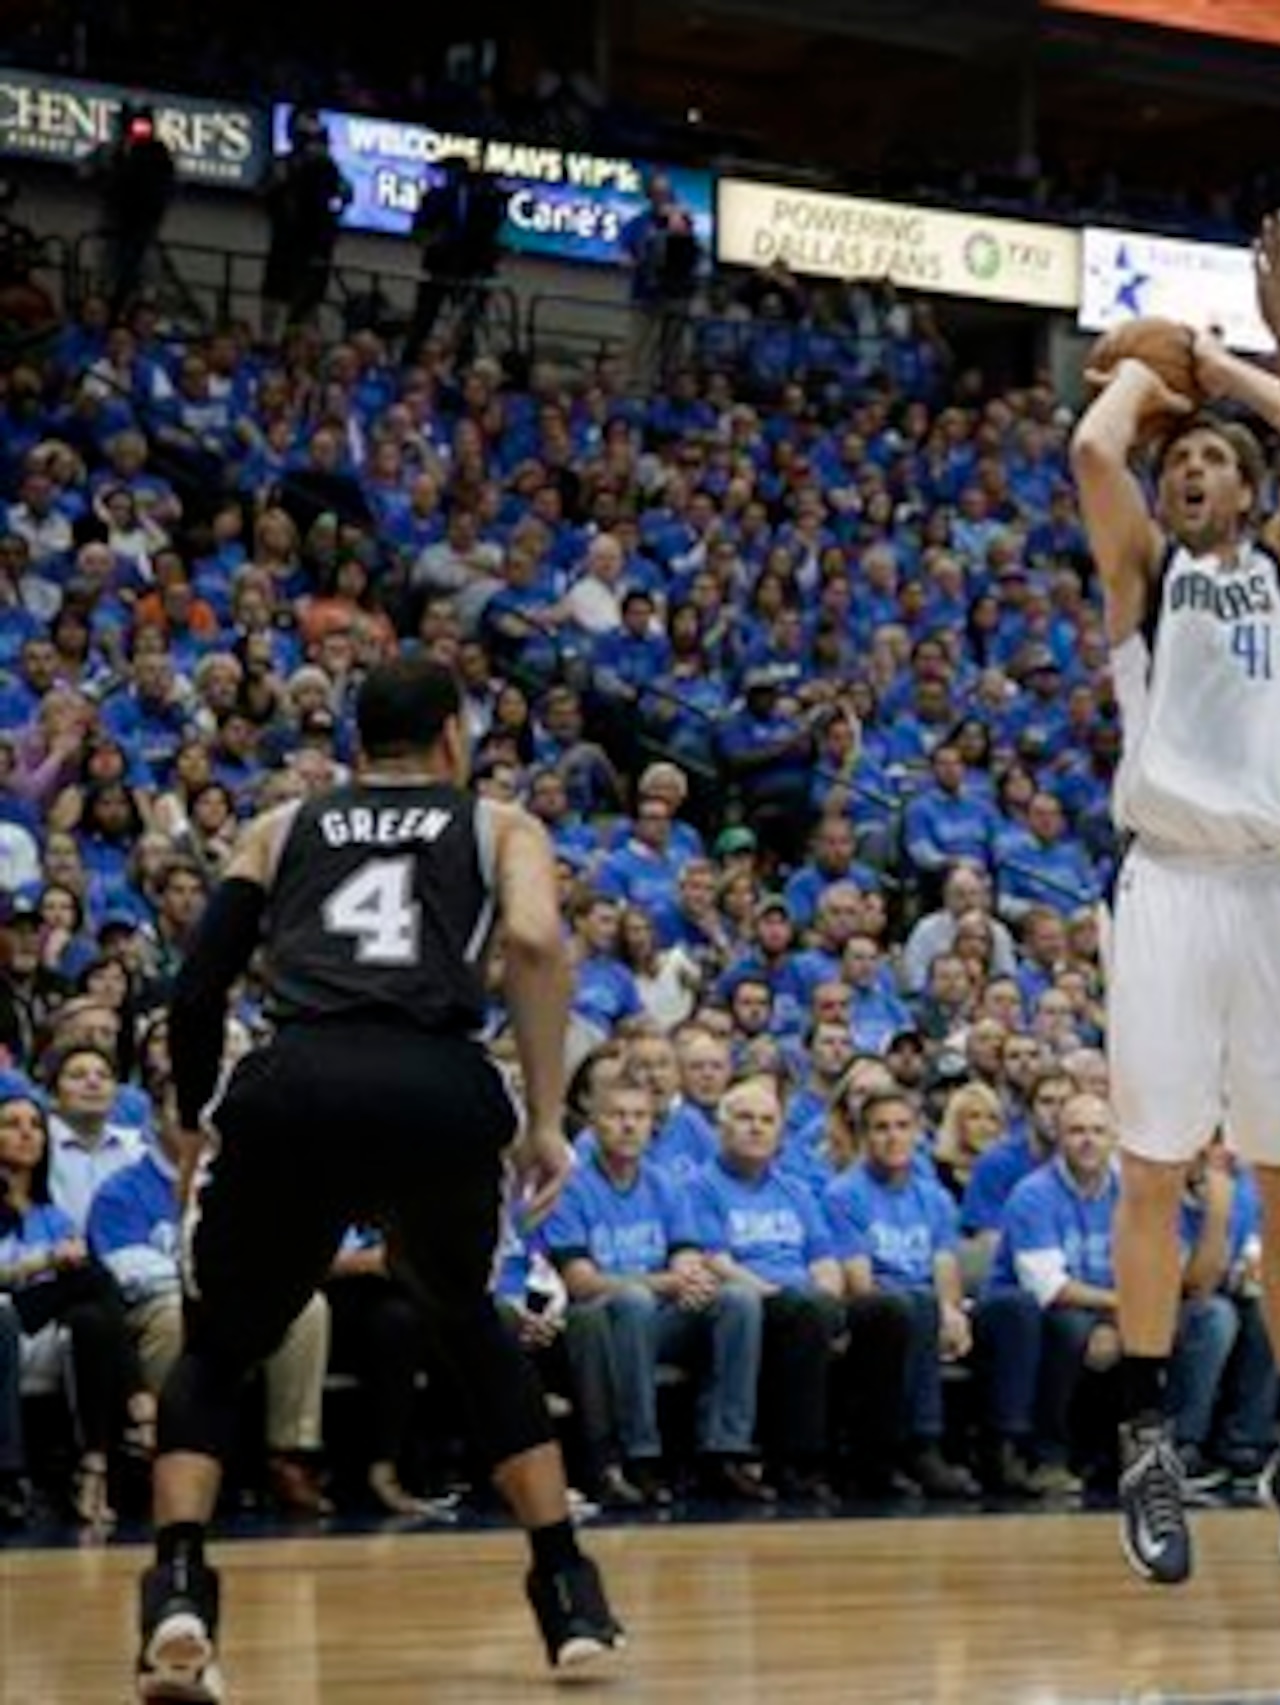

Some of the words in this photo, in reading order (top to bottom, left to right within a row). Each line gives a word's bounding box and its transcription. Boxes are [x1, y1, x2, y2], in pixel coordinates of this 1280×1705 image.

[484, 142, 563, 182] MAVS
[509, 189, 619, 240] Cane's
[770, 198, 927, 245] POWERING
[752, 229, 864, 272] DALLAS
[868, 243, 943, 281] FANS
[1231, 623, 1272, 680] 41
[320, 806, 452, 847] GREEN
[321, 854, 423, 966] 4
